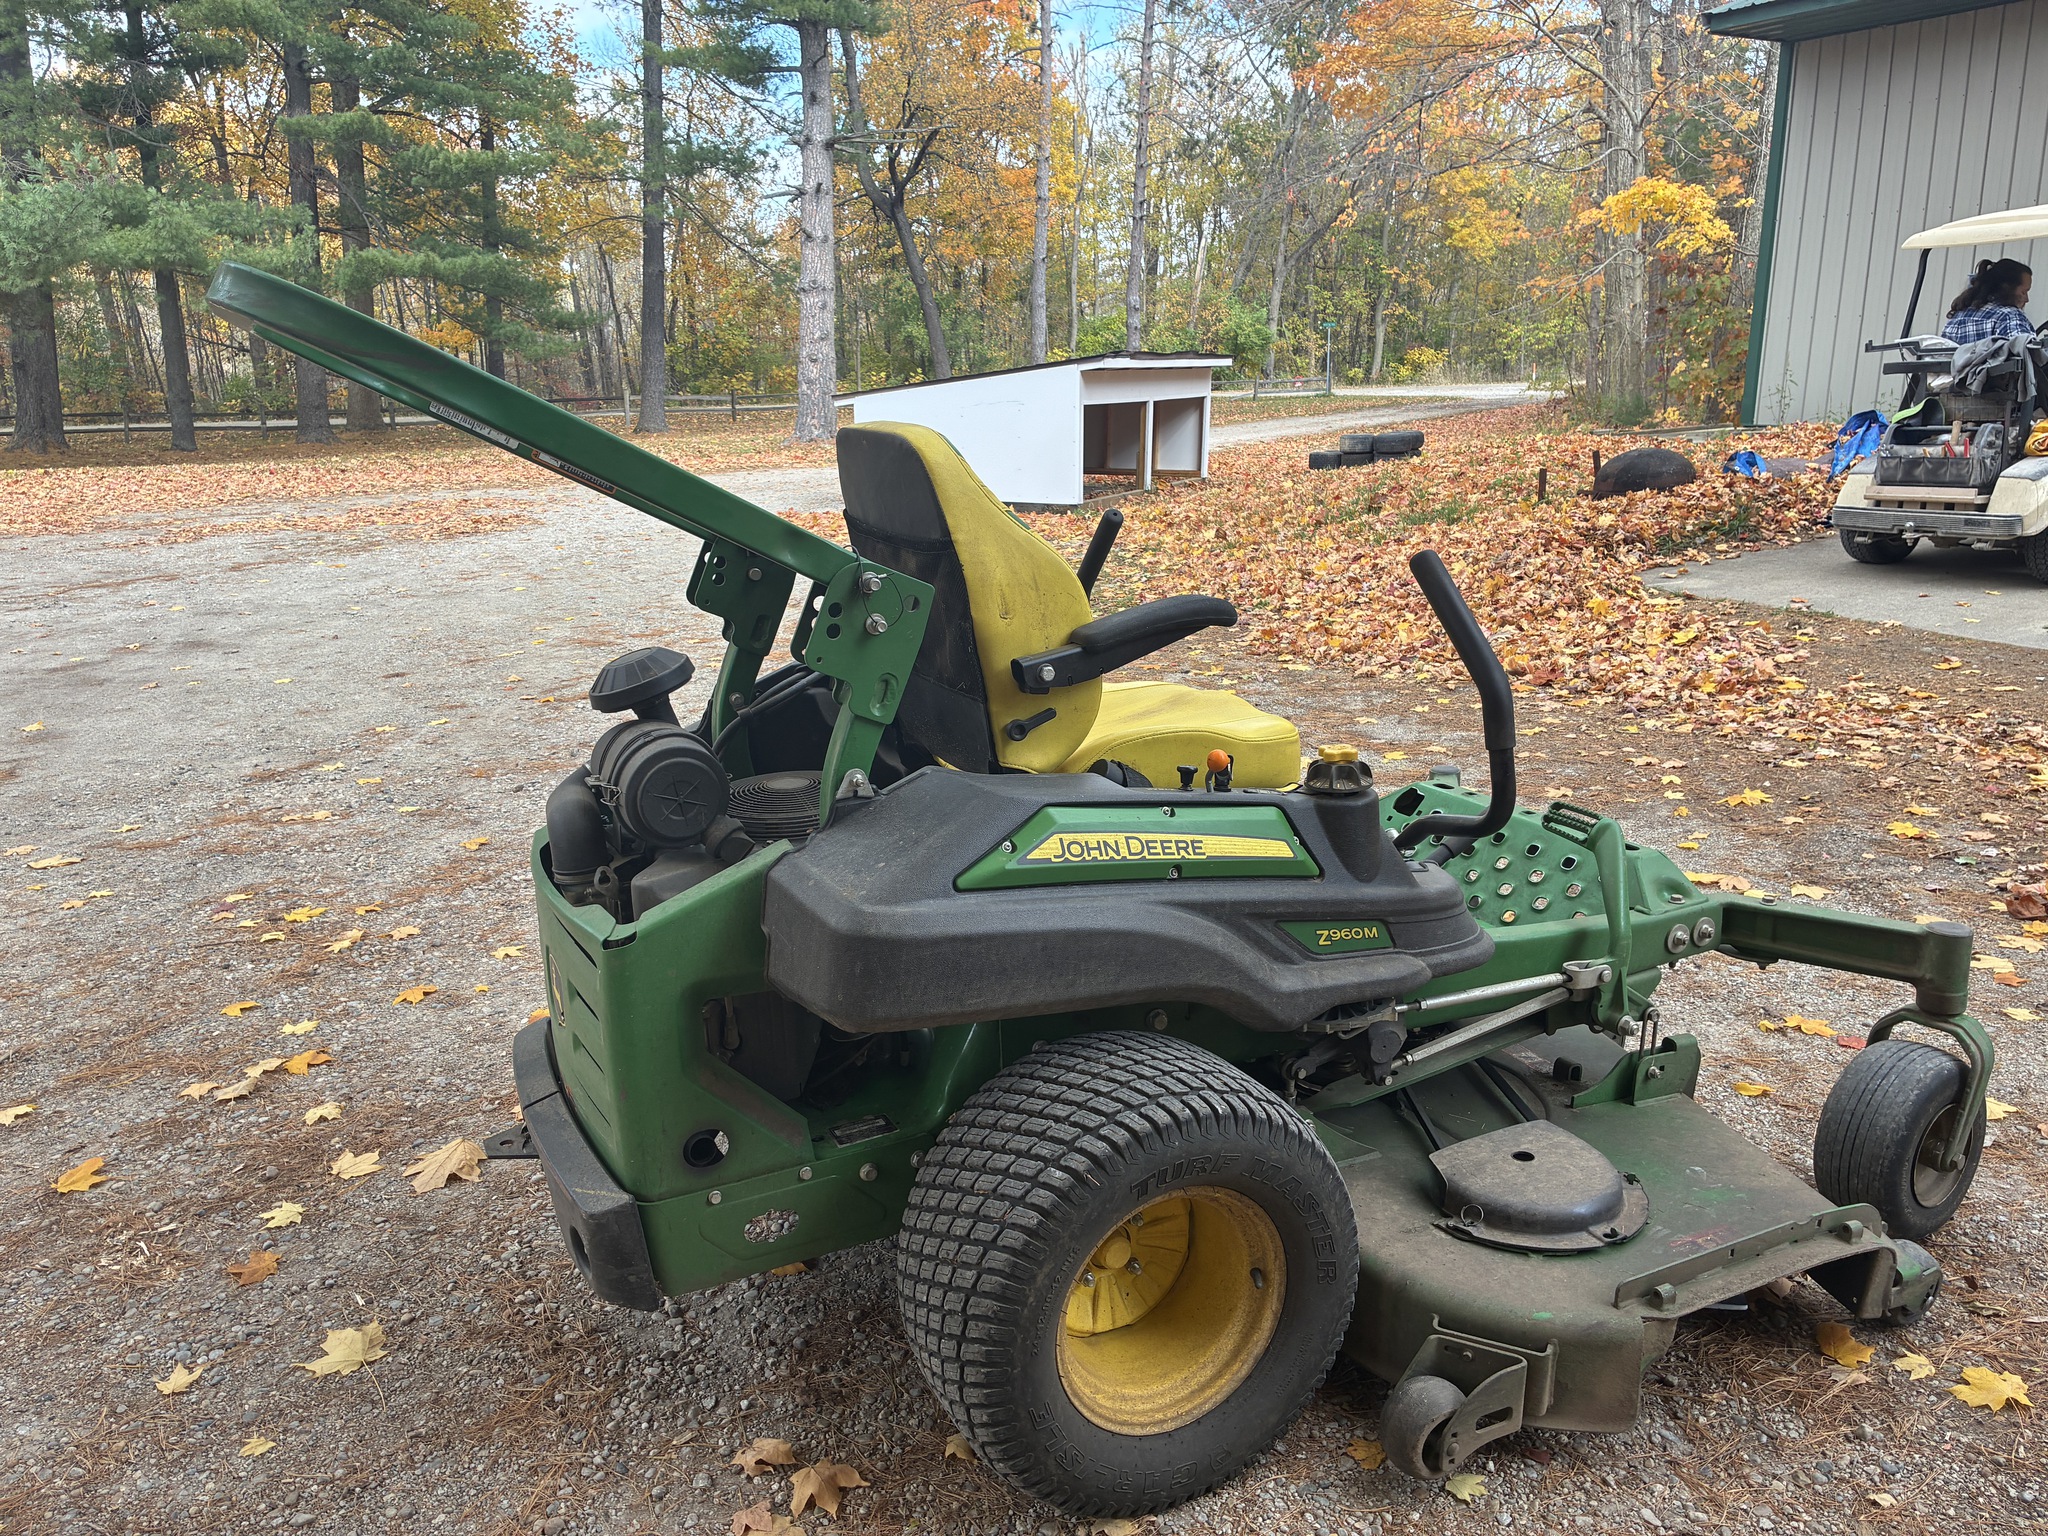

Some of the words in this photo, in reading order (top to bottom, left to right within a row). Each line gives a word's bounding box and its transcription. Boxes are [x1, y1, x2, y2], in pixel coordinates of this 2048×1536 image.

[1053, 837, 1122, 860] JOHN
[1124, 835, 1207, 858] DEERE
[1315, 926, 1380, 946] Z960M
[1130, 1153, 1241, 1199] TURF
[1241, 1156, 1337, 1285] MASTER
